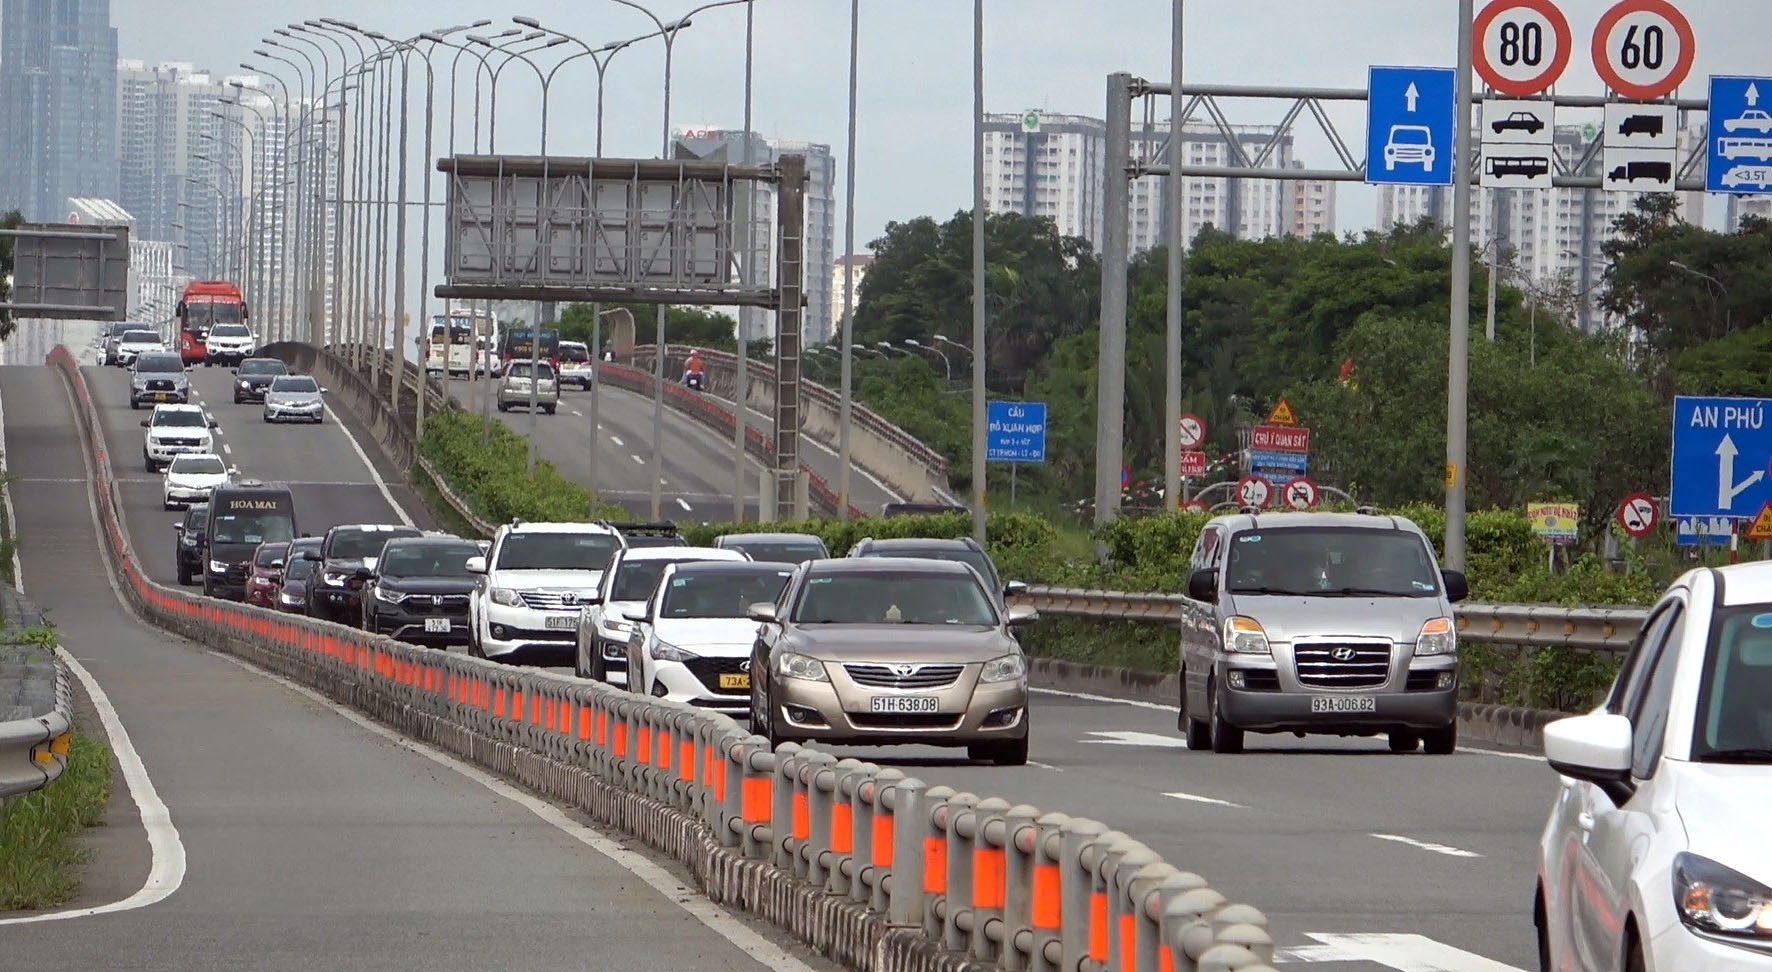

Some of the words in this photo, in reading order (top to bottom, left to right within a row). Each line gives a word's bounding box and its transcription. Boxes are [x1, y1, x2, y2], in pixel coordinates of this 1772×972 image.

[1500, 22, 1542, 66] 80
[1621, 25, 1664, 70] 60
[1691, 406, 1719, 428] AN
[1725, 401, 1764, 429] PHÚ
[1254, 431, 1270, 446] CHÚ
[1270, 432, 1275, 445] Ý
[1275, 433, 1293, 447] QUAN
[1293, 433, 1307, 448] SÁT
[230, 500, 253, 509] HOA
[254, 500, 277, 509] MAI
[873, 699, 938, 712] 51H-638.08
[1313, 699, 1374, 711] 93A-006.82
